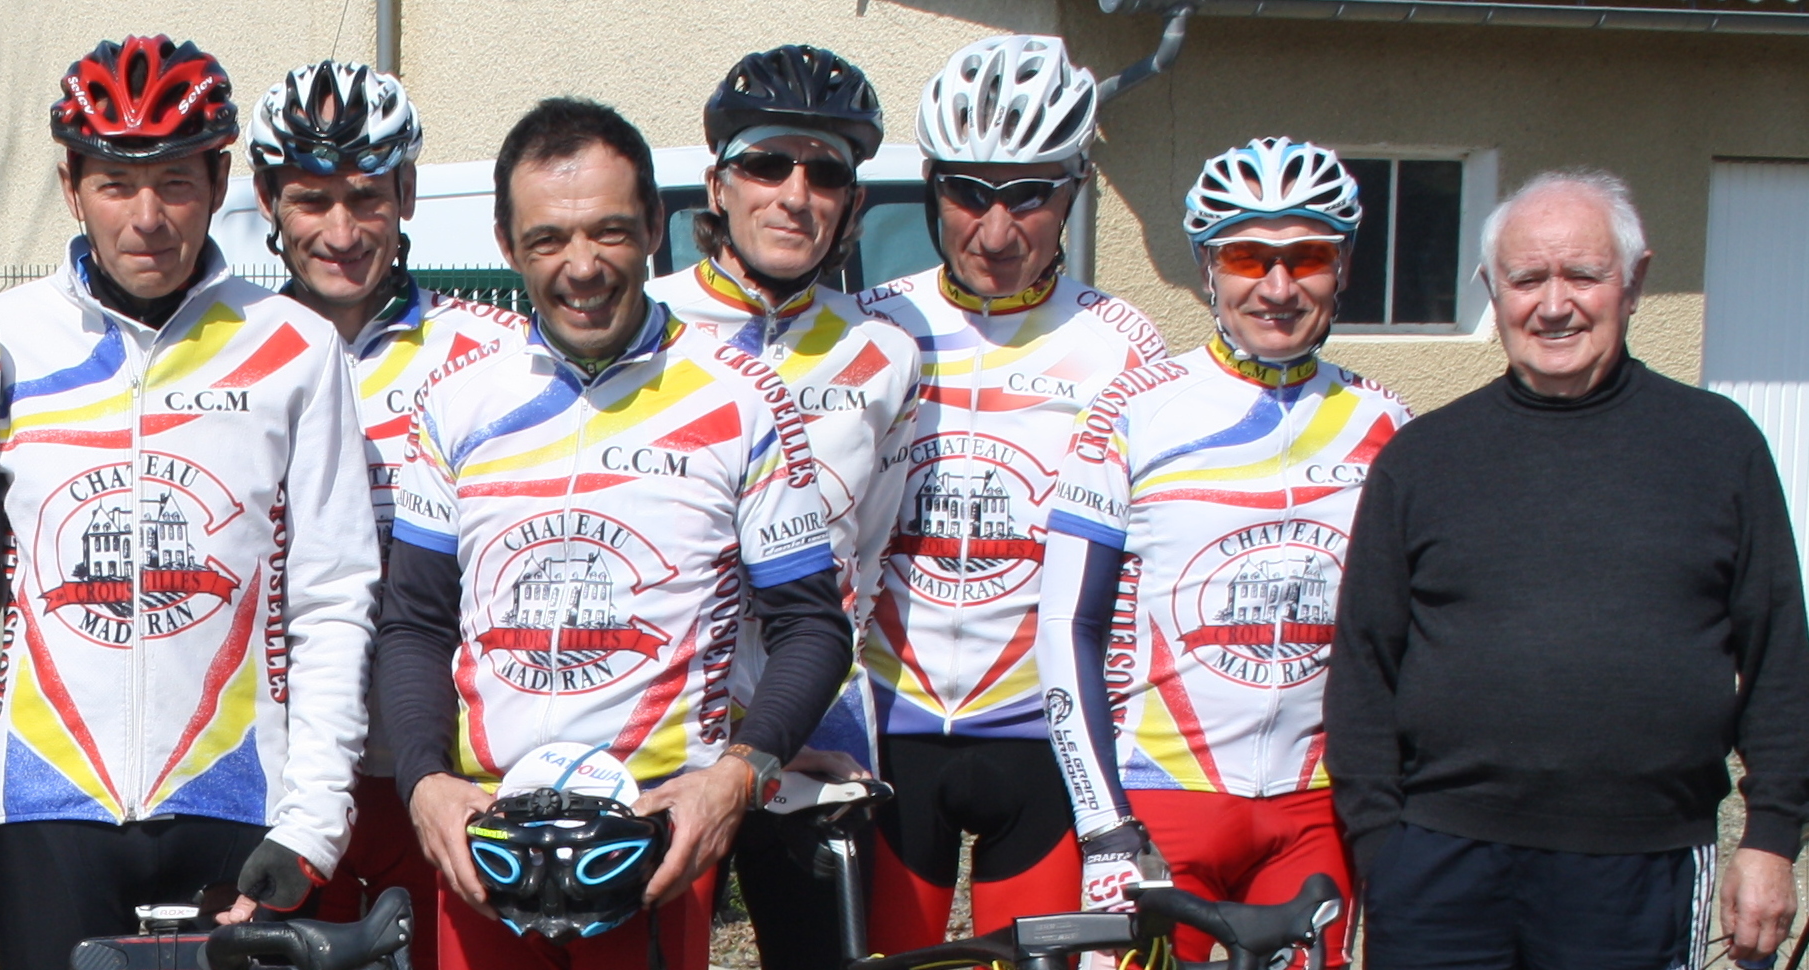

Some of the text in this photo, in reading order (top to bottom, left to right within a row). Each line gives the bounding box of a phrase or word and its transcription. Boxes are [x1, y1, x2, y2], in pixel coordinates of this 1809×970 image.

[164, 390, 251, 412] C.C.M
[799, 386, 868, 411] C.C.M
[1008, 373, 1077, 400] C.C.M
[714, 344, 817, 489] CROUSEILLES
[1076, 359, 1189, 465] CROUSEILLES
[601, 445, 691, 479] C.C.M
[910, 438, 1018, 466] CHATEAU
[68, 456, 200, 504] CHATEAU
[503, 513, 632, 553] CHATEAU
[1219, 521, 1343, 559] CHATEAU
